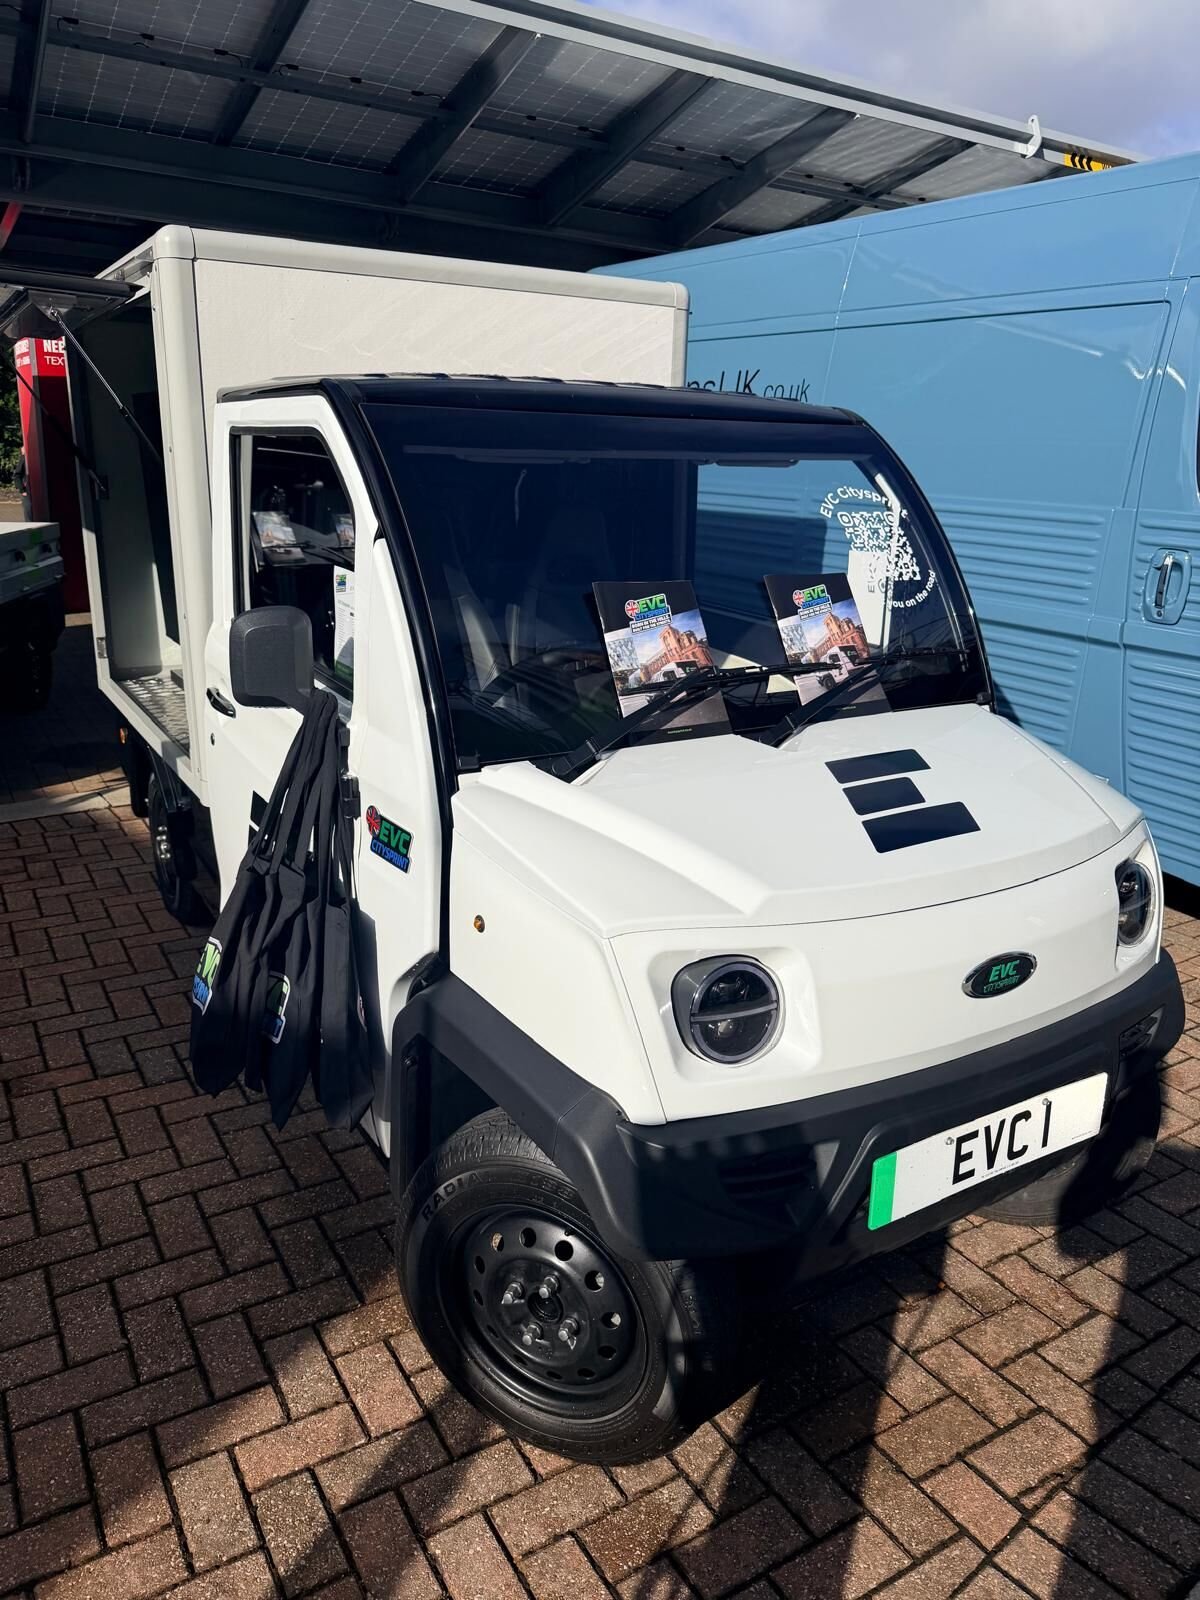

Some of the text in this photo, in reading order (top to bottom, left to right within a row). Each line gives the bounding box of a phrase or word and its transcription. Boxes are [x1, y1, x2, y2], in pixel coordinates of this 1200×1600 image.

[820, 486, 908, 518] EVC Citysprit
[639, 596, 665, 612] EVC
[804, 586, 826, 602] EVC
[905, 598, 917, 607] on
[915, 590, 928, 602] the
[926, 569, 936, 592] road
[379, 819, 411, 855] EVC
[371, 839, 409, 870] CITYSPRINT
[988, 959, 1020, 983] EVC
[952, 1110, 1032, 1185] EVC
[421, 1172, 496, 1223] RADIA
